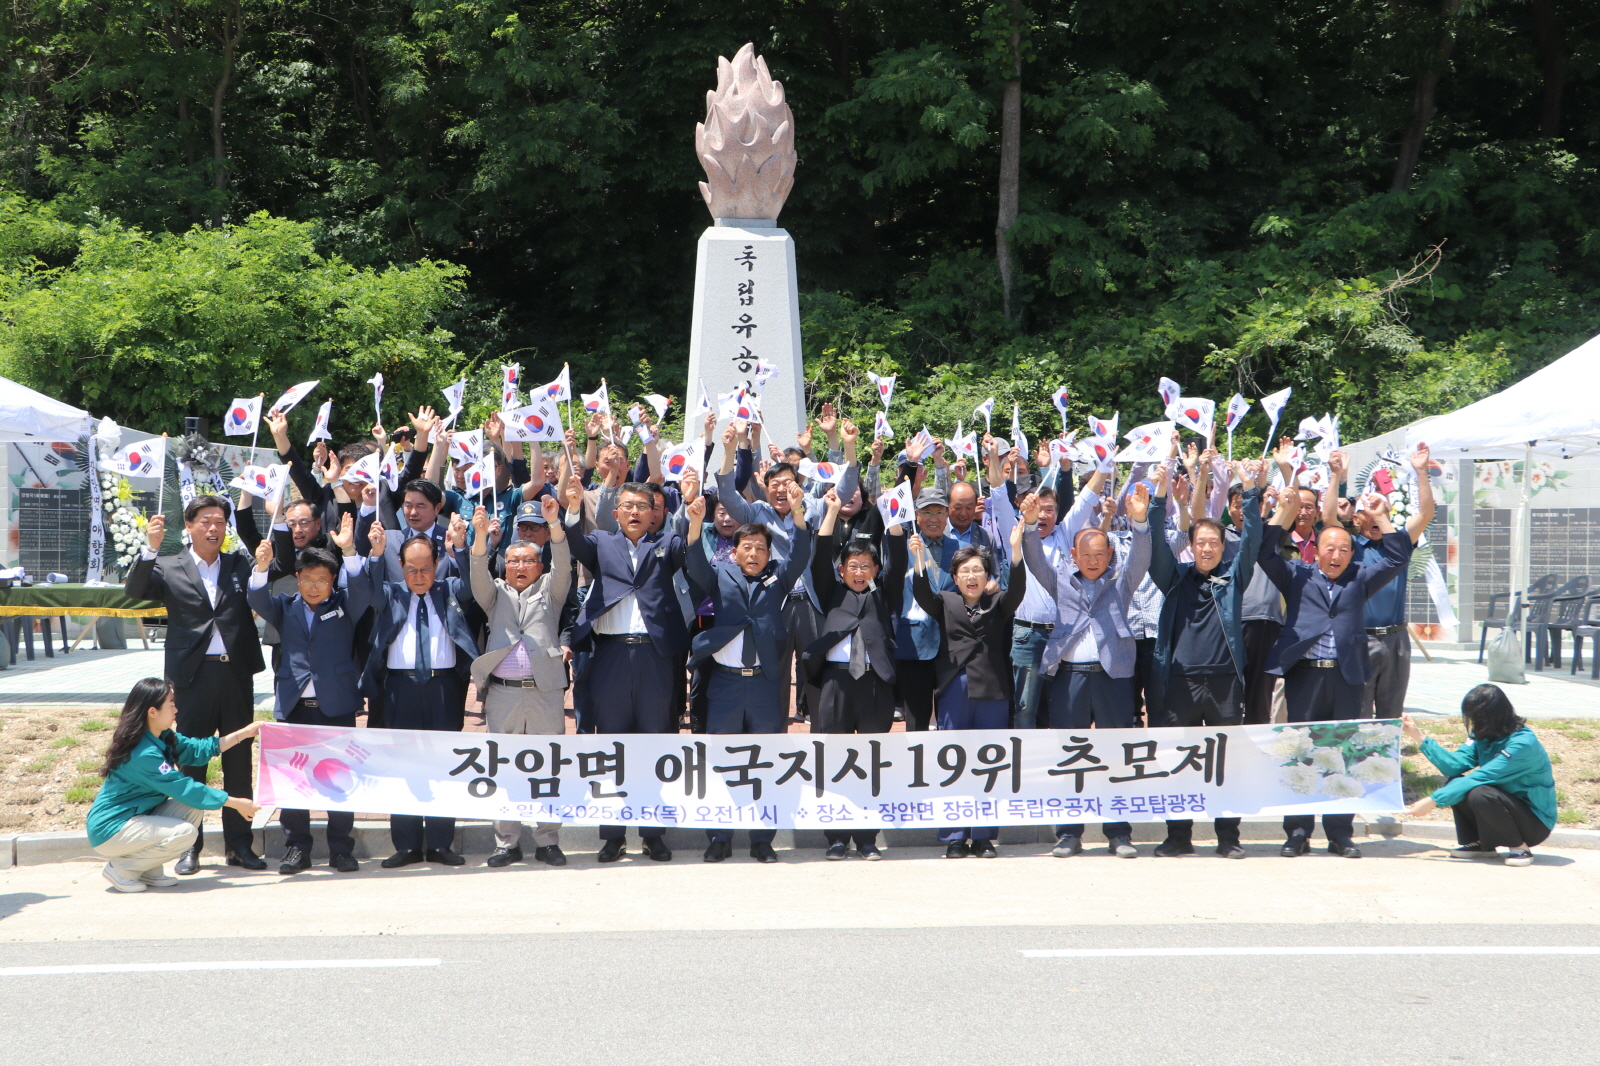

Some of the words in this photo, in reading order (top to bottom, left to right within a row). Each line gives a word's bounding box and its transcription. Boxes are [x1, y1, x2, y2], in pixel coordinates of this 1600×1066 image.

[448, 740, 628, 799] 장암면
[655, 741, 893, 801] 애국지사
[907, 736, 1022, 794] 19위
[1047, 733, 1228, 794] 추모제
[694, 804, 778, 824] 오전11시
[815, 803, 854, 823] 장소
[878, 801, 935, 822] 장암면
[942, 800, 1000, 821] 장하리
[1006, 797, 1103, 820] 독립유공자
[1109, 793, 1207, 816] 추모탑광장
